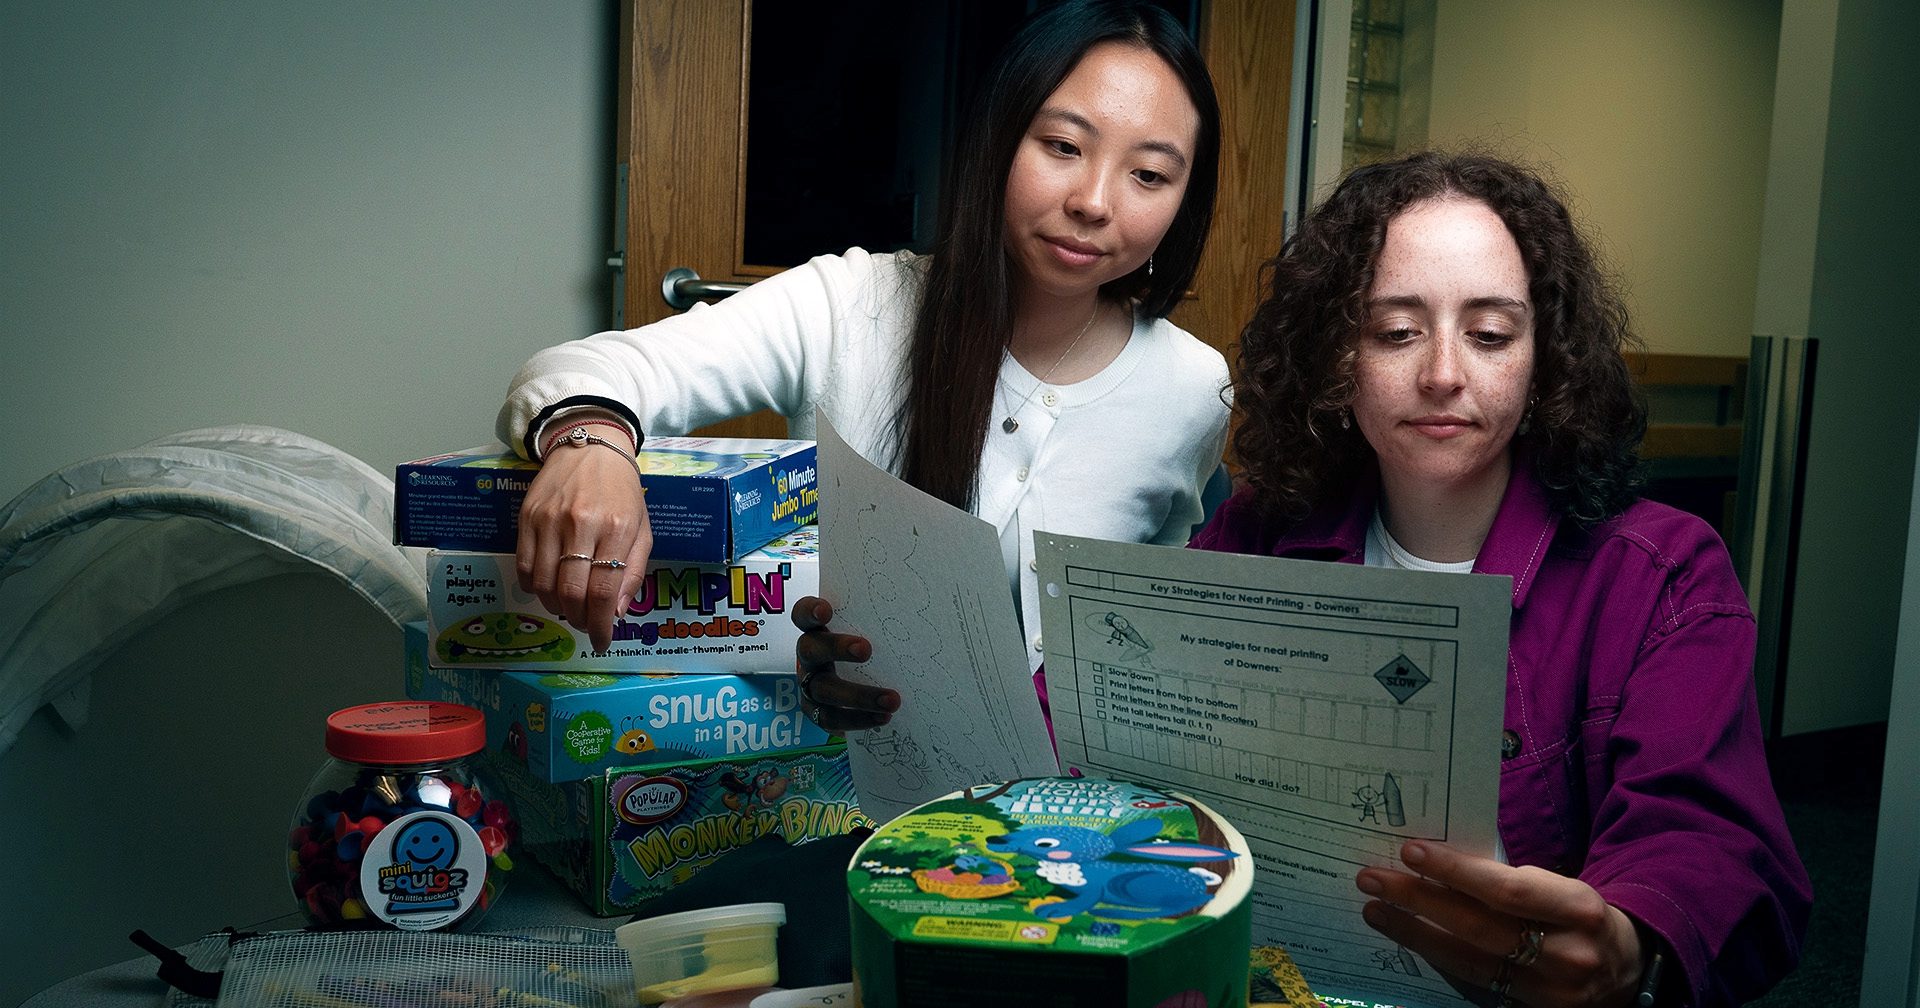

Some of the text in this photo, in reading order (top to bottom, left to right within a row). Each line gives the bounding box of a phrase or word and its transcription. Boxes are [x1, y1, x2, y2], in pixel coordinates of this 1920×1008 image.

[477, 478, 530, 491] 60 Minu
[778, 466, 816, 494] 60 Minute
[772, 495, 798, 522] Jumbo
[446, 564, 453, 575] 2
[464, 565, 471, 575] 4
[446, 577, 496, 592] players
[447, 593, 496, 606] Ages 4+
[1150, 583, 1169, 594] Key
[1172, 586, 1220, 600] Strategies
[1222, 591, 1236, 600] for
[1239, 594, 1263, 604] Neat
[1266, 596, 1304, 610] Printing
[1314, 601, 1360, 614] Downers
[656, 644, 736, 655] doodle-thumpin'
[738, 642, 769, 654] game!
[1180, 634, 1329, 662] My strategies for neat printing
[1224, 658, 1282, 673] of Downers:
[1108, 667, 1128, 678] Slow
[1130, 671, 1154, 682] down
[1386, 677, 1417, 688] SLOW
[1110, 680, 1238, 710] Print letters from top to bottom
[741, 697, 759, 713] as
[763, 696, 772, 710] a
[1110, 692, 1128, 701] Print
[1130, 696, 1155, 708] letters
[1170, 703, 1184, 713] the
[1187, 707, 1202, 717] line
[1204, 710, 1219, 720] (no
[1221, 713, 1258, 728] floaters)
[1112, 704, 1129, 713] Print
[1131, 707, 1144, 717] tall
[1146, 710, 1172, 722] letters
[1173, 715, 1186, 725] tall
[580, 720, 587, 730] A
[1113, 715, 1130, 725] Print
[1132, 720, 1154, 730] small
[1156, 723, 1181, 736] letters
[1183, 730, 1206, 741] small
[566, 727, 611, 740] Cooperative
[695, 728, 710, 743] in
[714, 725, 723, 740] a
[572, 736, 604, 747] Game for
[579, 744, 600, 756] Kids!
[1038, 781, 1120, 791] HOPPY
[1235, 773, 1255, 783] How
[1258, 779, 1274, 787] did
[1282, 784, 1300, 793] do?
[629, 788, 675, 808] POPULAR
[629, 796, 877, 880] MONKEY BING
[380, 863, 410, 877] mini
[1264, 854, 1277, 863] for
[1278, 859, 1299, 869] neat
[1301, 865, 1338, 878] printing
[383, 868, 464, 894] squigz
[405, 893, 422, 901] little
[424, 891, 456, 901] suckers!
[1267, 937, 1286, 945] How
[1325, 996, 1368, 1007] PAPEL
